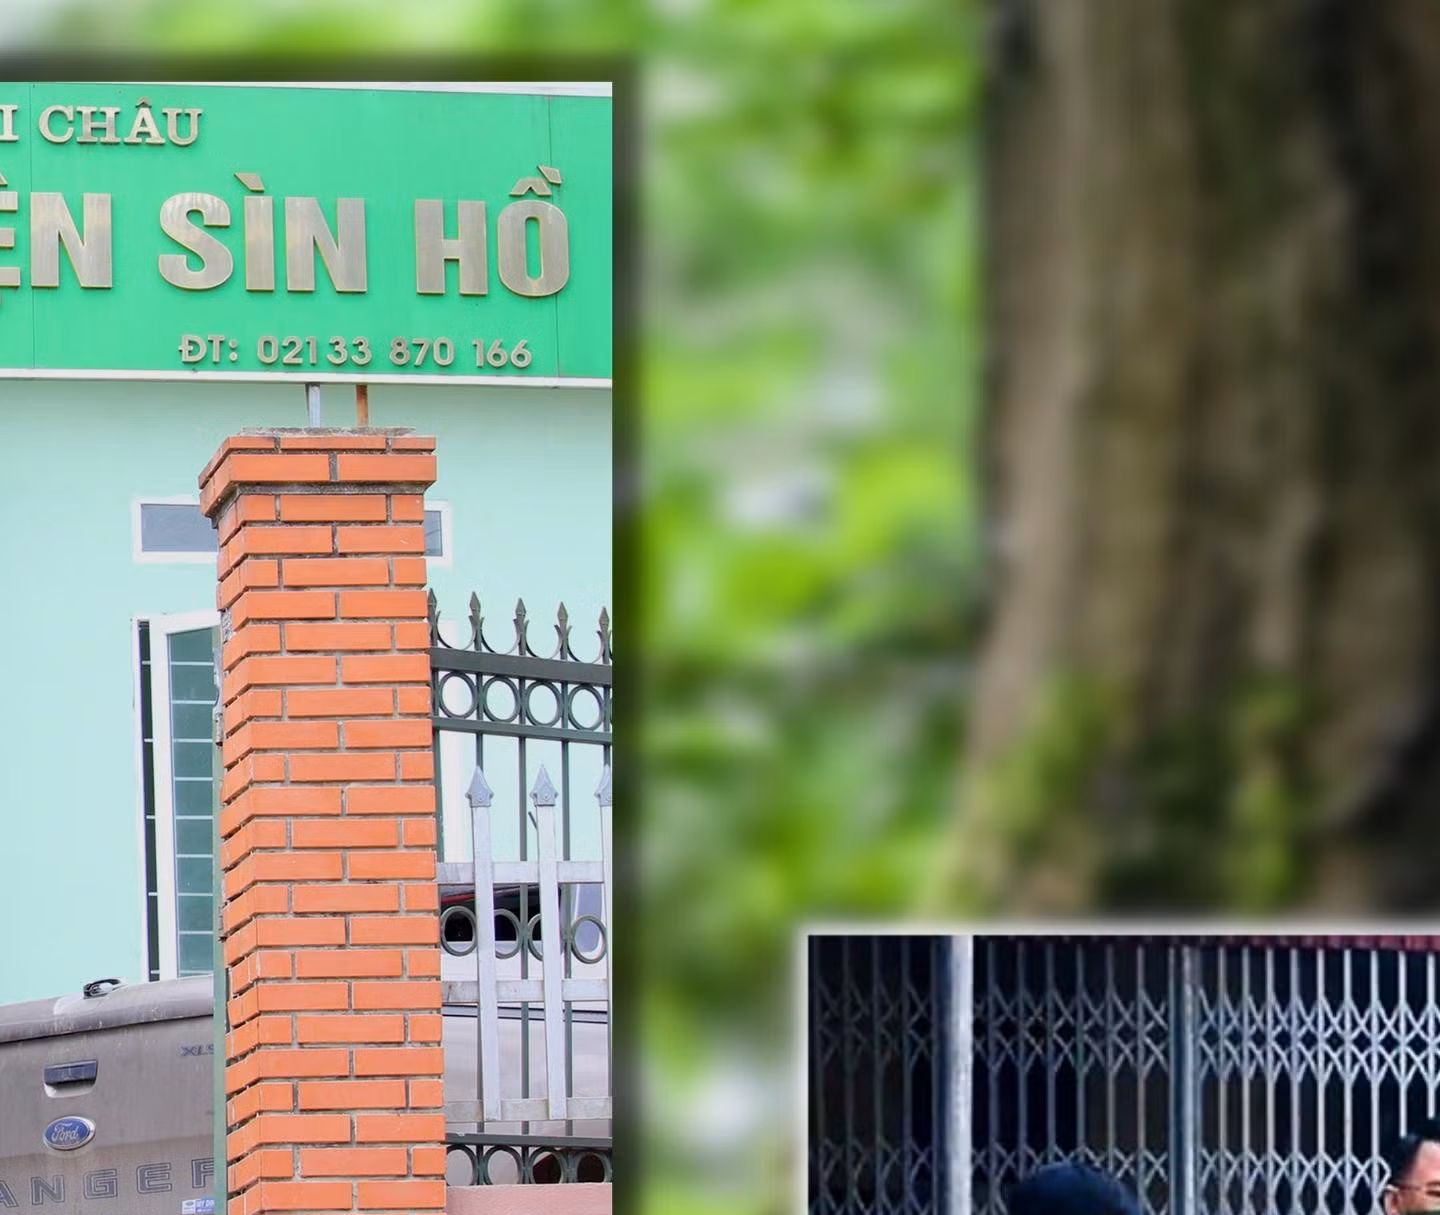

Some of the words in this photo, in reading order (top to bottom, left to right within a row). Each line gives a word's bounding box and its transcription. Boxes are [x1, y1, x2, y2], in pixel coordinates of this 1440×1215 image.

[38, 97, 203, 147] CHÂU
[159, 172, 368, 293] SÌN
[415, 165, 571, 298] HỒ
[180, 334, 238, 363] ĐT:
[390, 338, 454, 366] 870
[474, 339, 532, 368] 166
[51, 1122, 81, 1142] Ford
